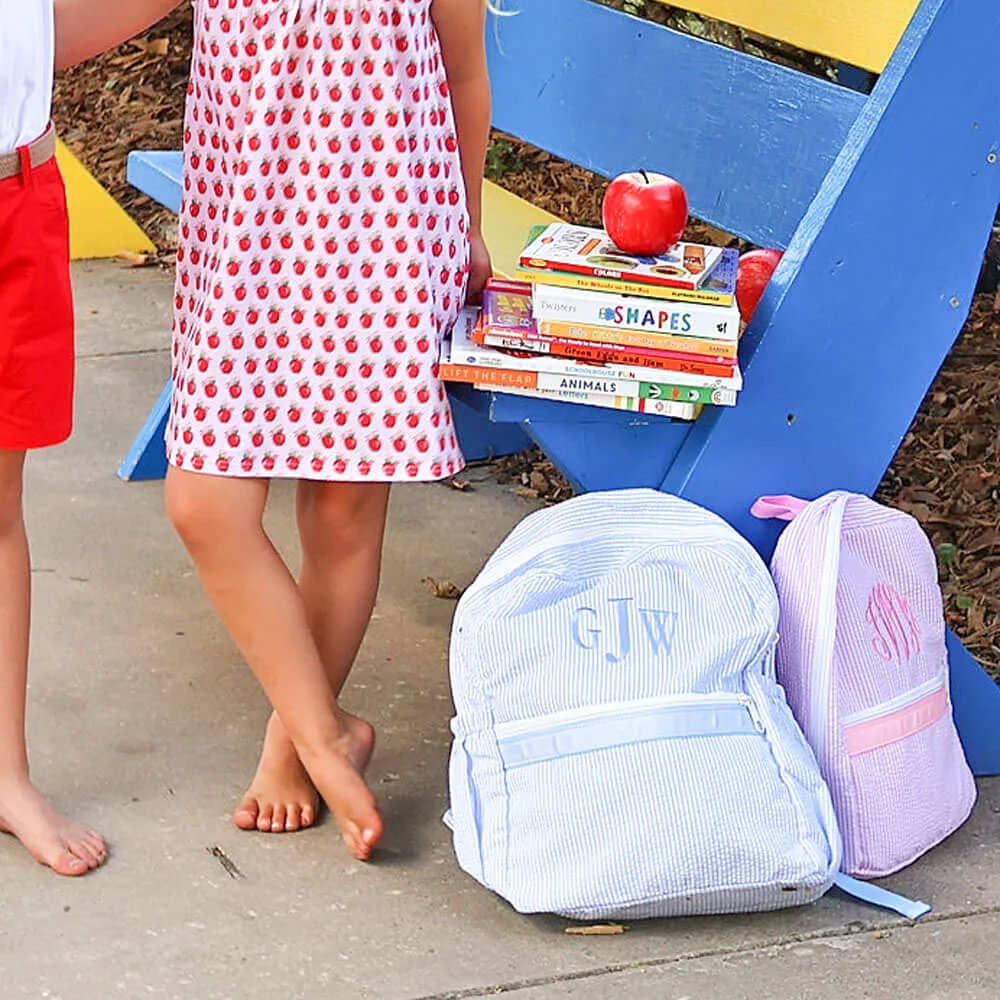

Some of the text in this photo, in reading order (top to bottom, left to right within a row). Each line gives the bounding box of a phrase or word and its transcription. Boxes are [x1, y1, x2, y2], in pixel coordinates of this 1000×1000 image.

[614, 305, 692, 332] SHAPES
[564, 346, 592, 358] Green
[622, 355, 640, 364] and
[443, 367, 532, 383] LIFT THE FLAP
[560, 378, 617, 393] ANIMALS
